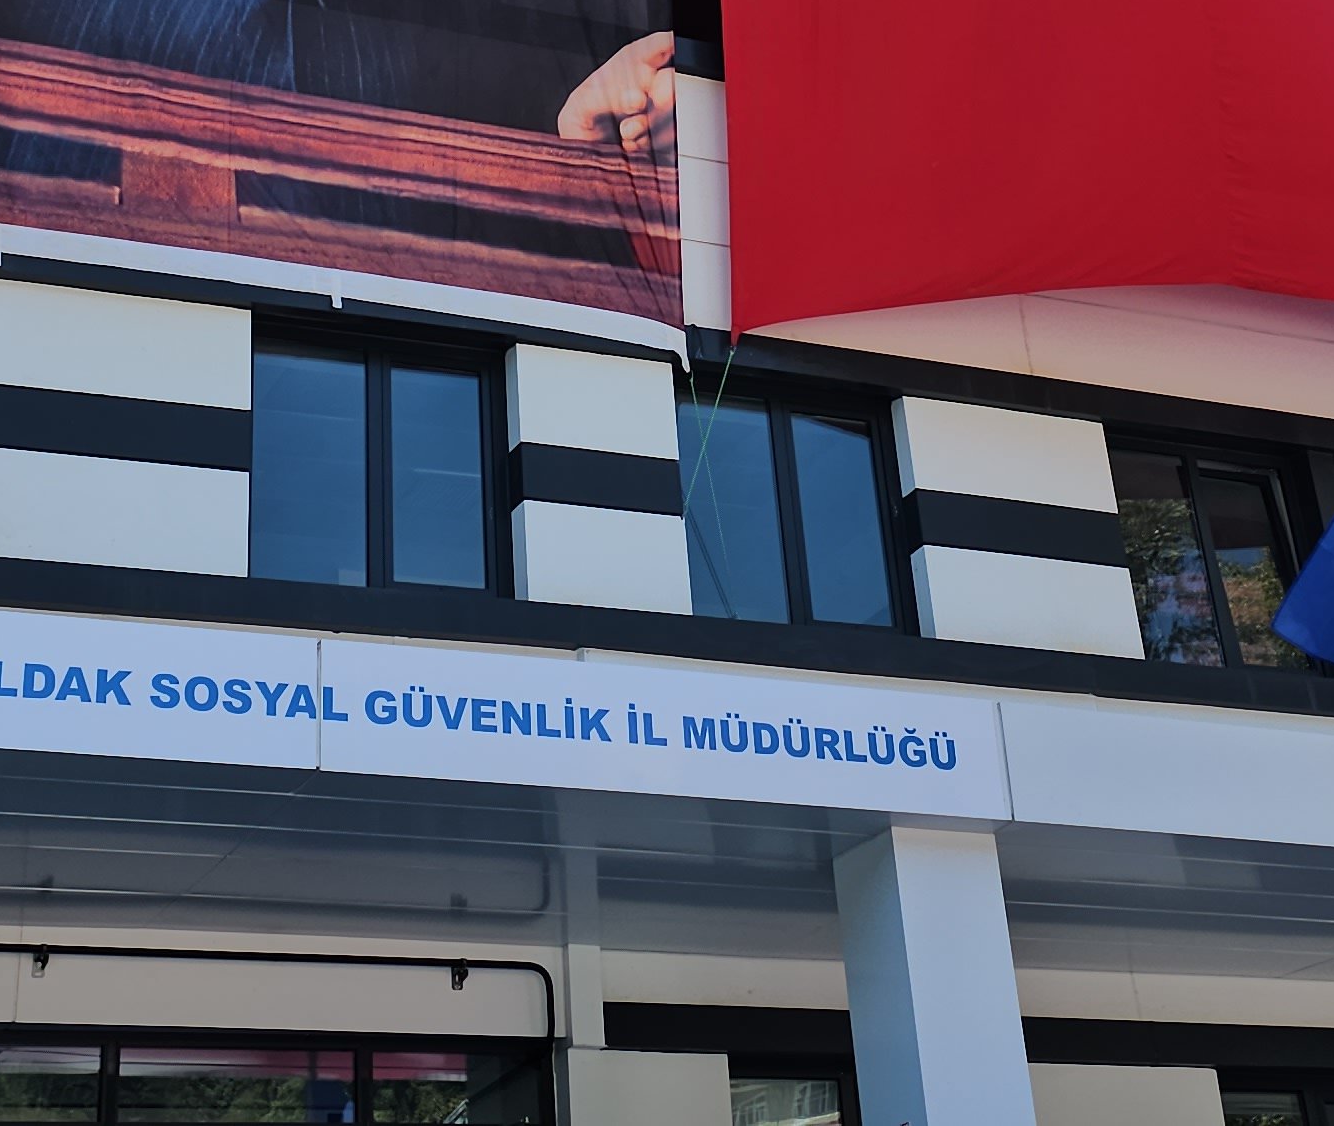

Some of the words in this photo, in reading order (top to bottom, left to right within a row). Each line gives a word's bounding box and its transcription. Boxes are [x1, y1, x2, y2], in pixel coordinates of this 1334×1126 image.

[149, 671, 350, 724] SOSYAL
[363, 684, 612, 743] GÜVENLİK
[626, 702, 668, 747] İL
[682, 712, 957, 772] MÜDÜRLÜĞÜ
